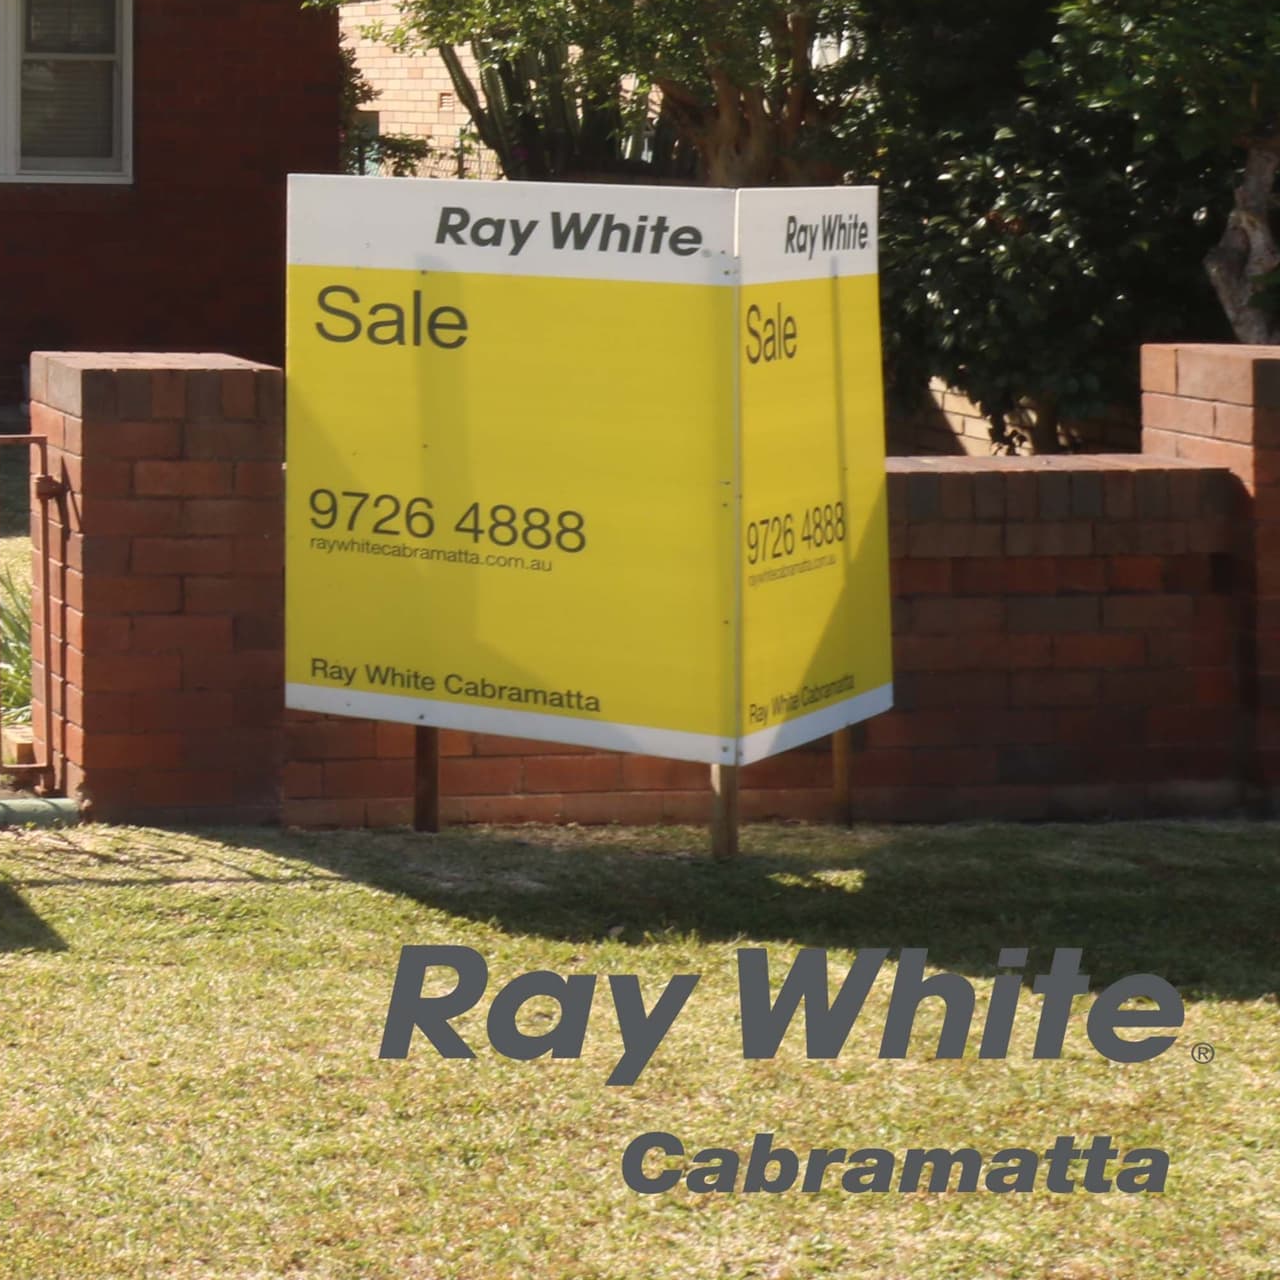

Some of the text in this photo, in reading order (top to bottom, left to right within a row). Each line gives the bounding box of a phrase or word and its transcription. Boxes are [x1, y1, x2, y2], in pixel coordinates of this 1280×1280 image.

[434, 206, 702, 258] Ray White
[784, 213, 869, 261] Ray White
[315, 284, 469, 350] Sale
[745, 302, 797, 365] Sale
[309, 488, 587, 554] 9726 4888
[747, 501, 846, 565] 9726 4888
[309, 535, 553, 572] raywhitecabramatta.com.au
[310, 657, 601, 713] Ray White Cabramatta
[748, 703, 768, 726] Ray
